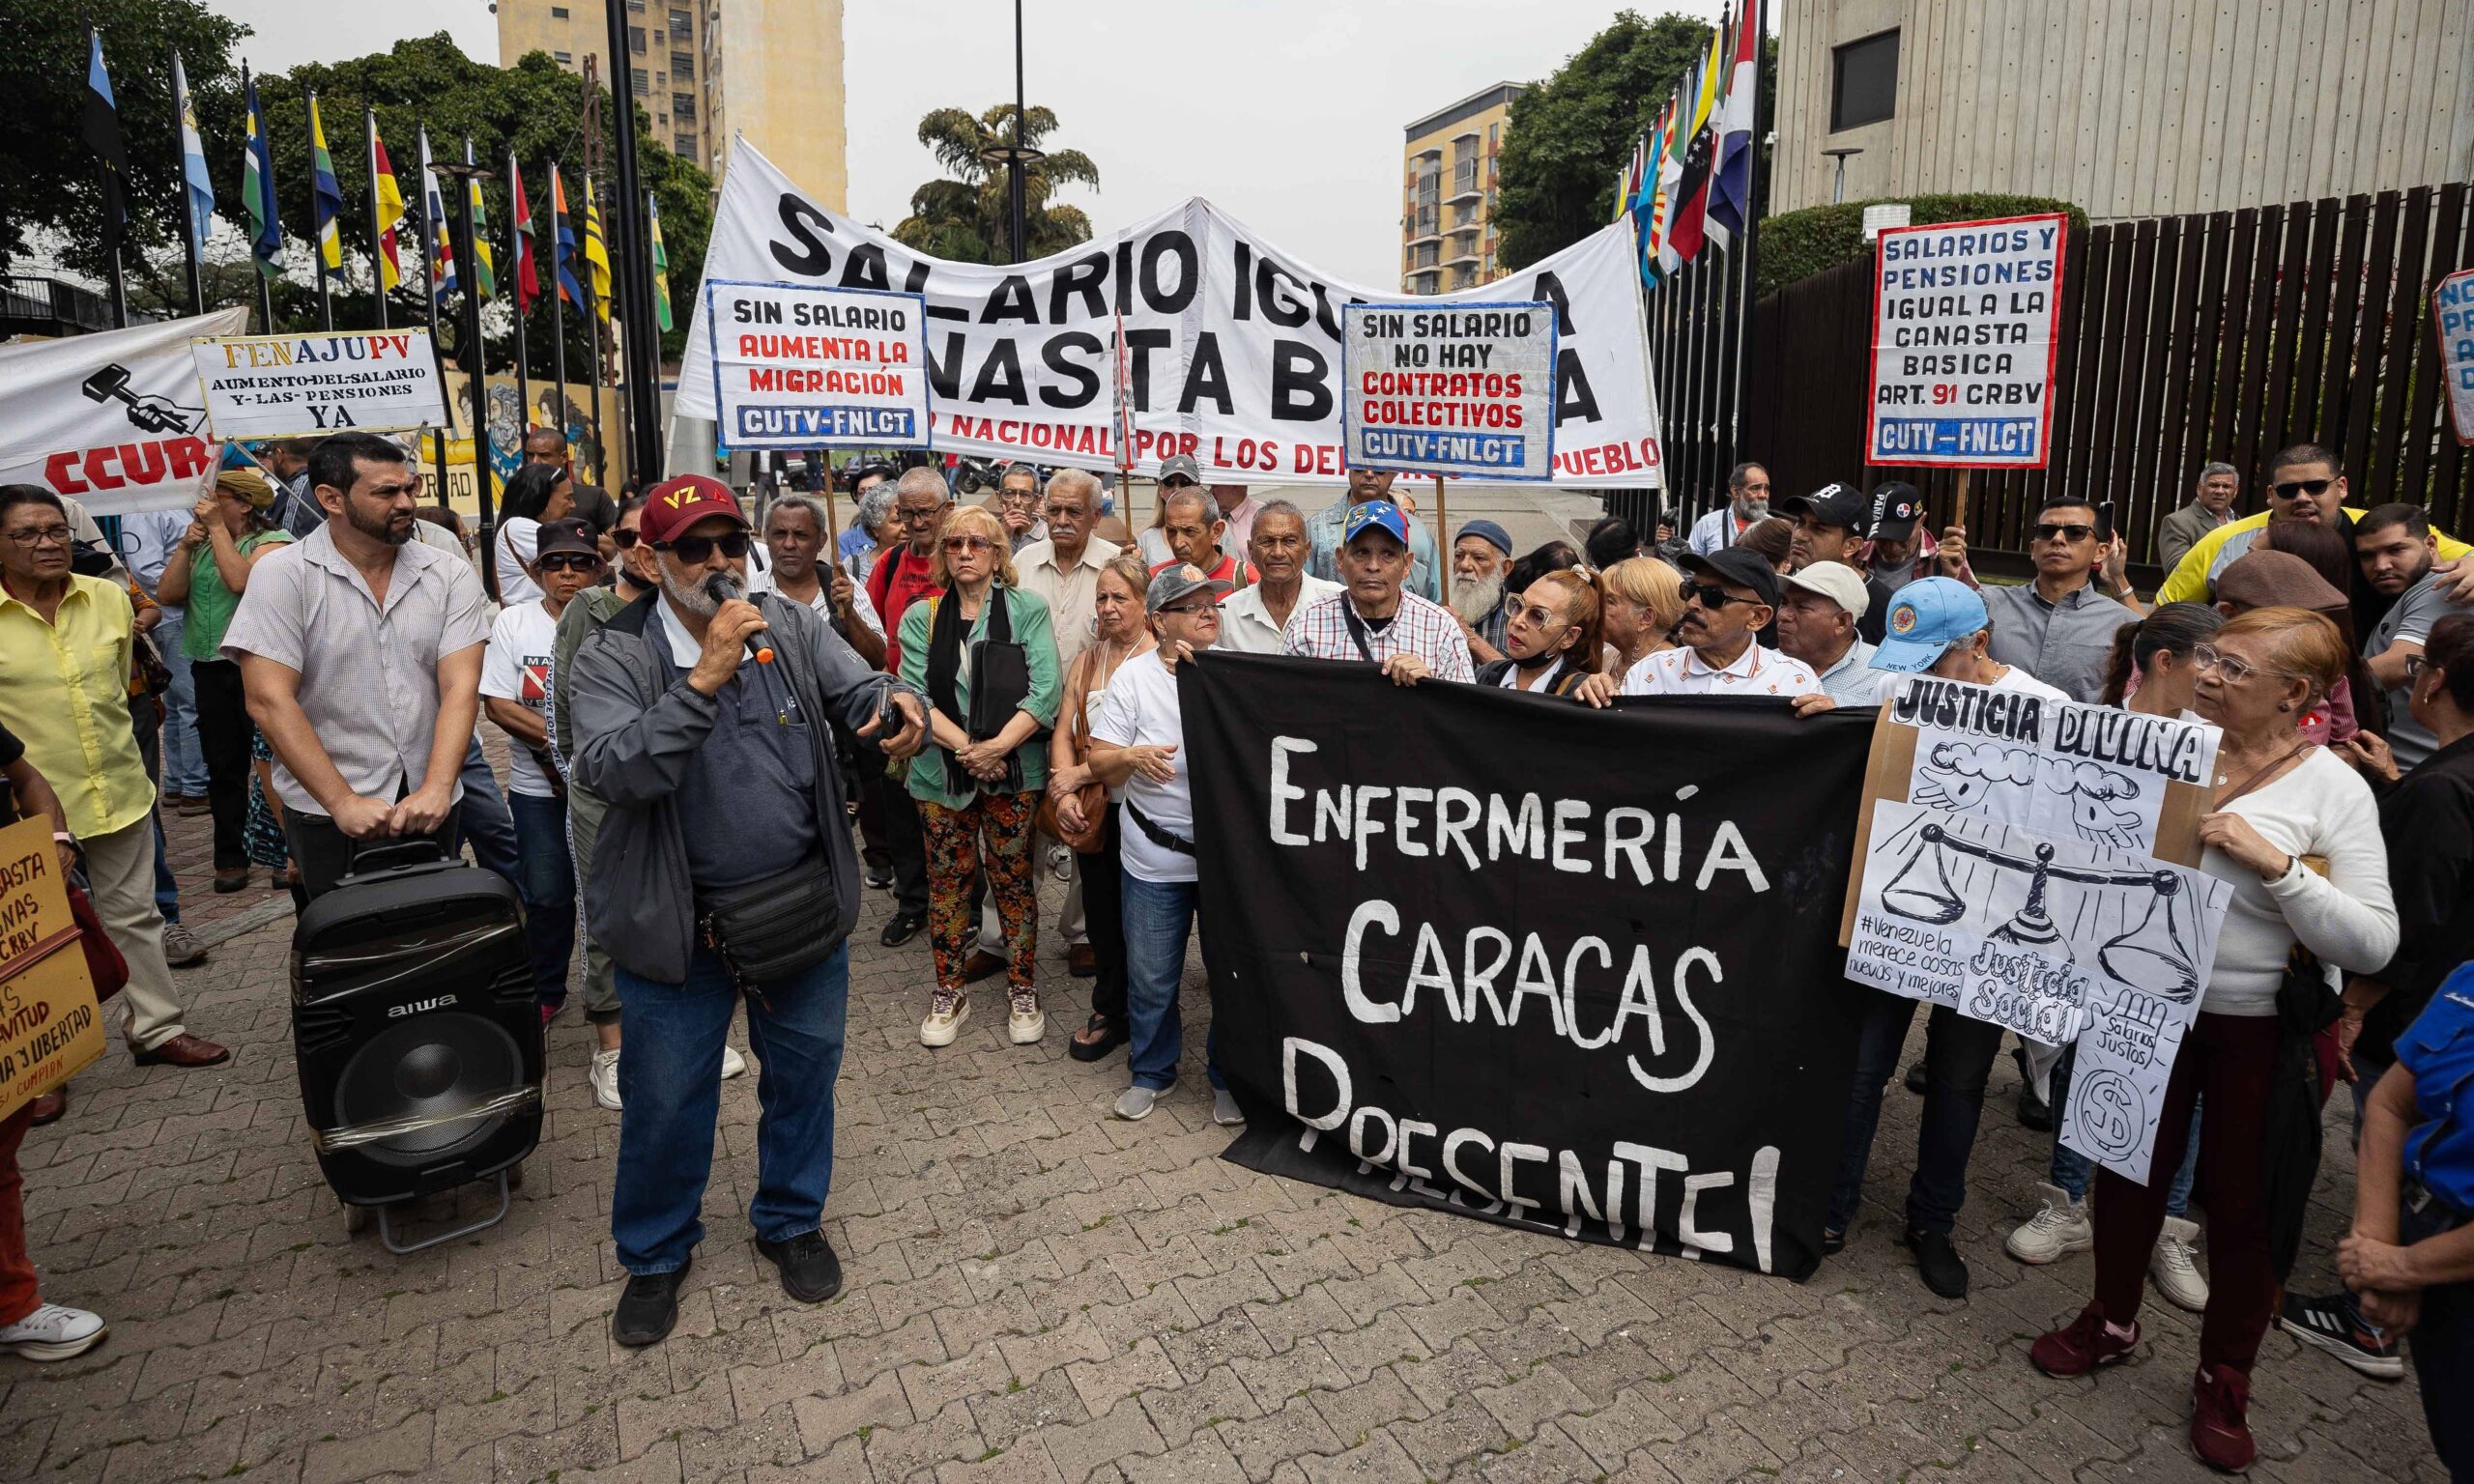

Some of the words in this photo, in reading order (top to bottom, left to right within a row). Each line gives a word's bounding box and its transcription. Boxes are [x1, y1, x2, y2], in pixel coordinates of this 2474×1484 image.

[1885, 229, 2028, 262] SALARIOS
[2039, 227, 2057, 250] Y
[1884, 259, 2054, 291] PENSIONES
[734, 299, 783, 325] SIN
[793, 303, 906, 331] SALARIO
[1887, 295, 1972, 320] IGUAL
[1980, 293, 1998, 316] A
[2010, 291, 2045, 314] LA
[1364, 314, 1404, 338] SIN
[1413, 312, 1531, 338] SALARIO
[1895, 322, 2028, 349] CANASTA
[222, 335, 410, 368] FENAJUPV
[739, 334, 871, 362] AUMENTA
[878, 341, 907, 364] LA
[1395, 344, 1428, 368] NO
[1439, 344, 1493, 369] HAY
[928, 328, 1234, 415] NASTA
[1903, 353, 2012, 376] BASICA
[306, 385, 413, 401] PENSIONES
[749, 365, 904, 396] MIGRACIÓN
[1363, 371, 1523, 398] CONTRATOS
[1878, 385, 1925, 406] ART.
[1932, 384, 1958, 405] 91
[1966, 383, 2043, 405] CRBV
[306, 405, 357, 429] YA
[744, 410, 908, 436] CUTV-FNLCT
[1364, 400, 1523, 428] COLECTIVOS
[952, 414, 1115, 458] NACIONAL
[1136, 429, 1198, 461] POR
[1216, 436, 1279, 471] LOS
[1366, 433, 1520, 463] CUTV-FNLCT
[44, 433, 216, 495] CCUR
[1885, 663, 1908, 671] NEW
[1912, 654, 1934, 670] YORK
[1894, 678, 2042, 744] JUSTICIA
[2055, 705, 2204, 783] DIVINA
[1270, 736, 1770, 893] ENFERMERÍA
[1861, 916, 1952, 956] #Venezuela
[1849, 958, 1893, 982] nuevas
[1858, 938, 1916, 966] merece
[1921, 956, 1965, 978] cosas
[1971, 941, 2089, 1008] Justicia
[388, 993, 458, 1017] aiwa
[1342, 899, 1723, 1093] CARACAS
[1970, 979, 2078, 1046] Social
[2107, 1017, 2156, 1048] Salarios
